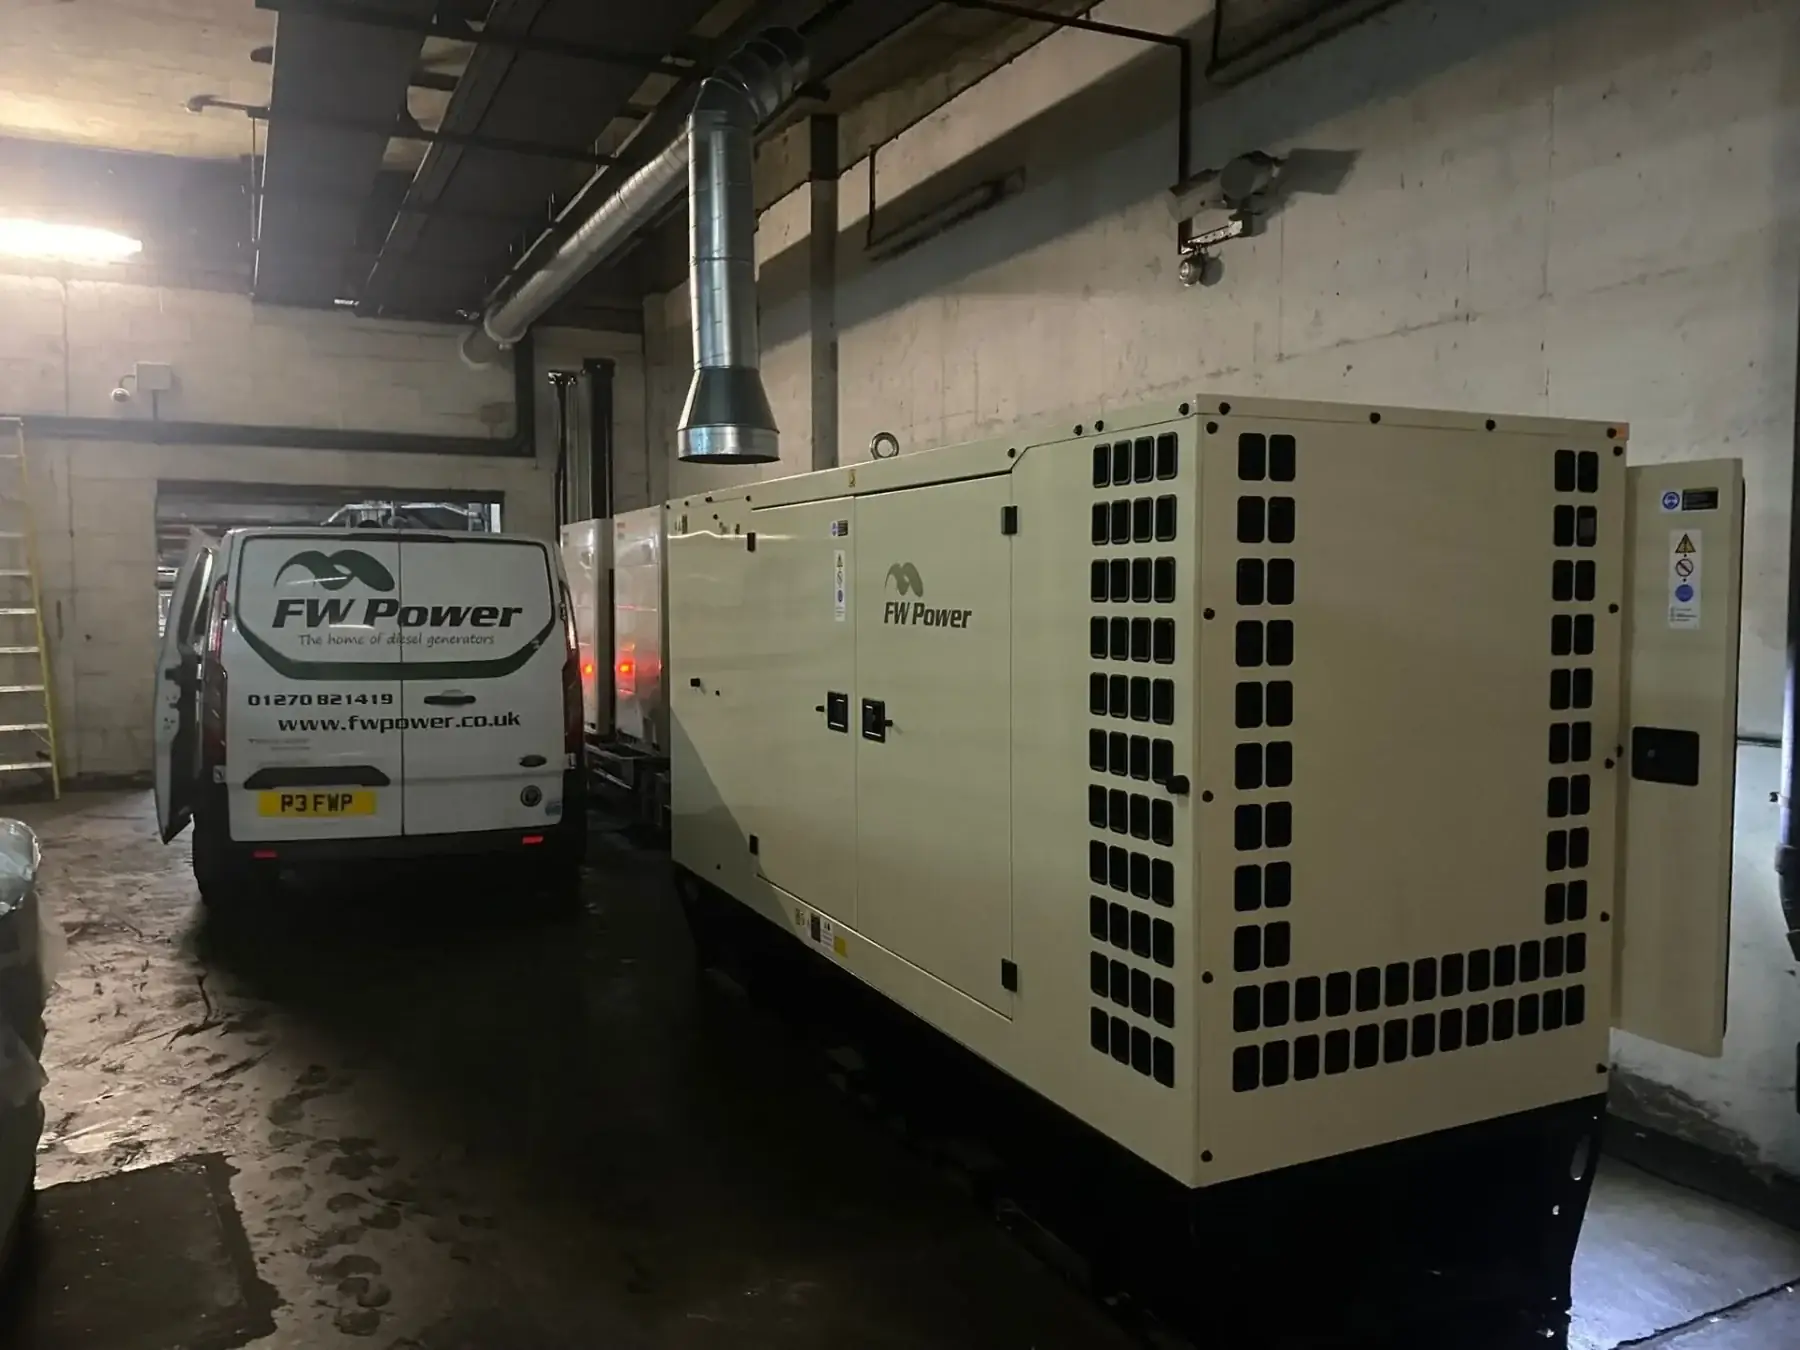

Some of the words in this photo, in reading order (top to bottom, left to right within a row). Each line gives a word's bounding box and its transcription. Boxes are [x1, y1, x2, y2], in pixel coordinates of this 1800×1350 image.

[272, 598, 356, 628] FW
[363, 598, 523, 628] Power
[884, 602, 910, 625] FW
[912, 602, 972, 629] Power
[298, 633, 322, 646] The
[328, 632, 364, 646] home
[369, 632, 386, 646] of
[386, 632, 422, 647] diesel
[427, 633, 495, 648] generators
[248, 694, 313, 706] 01270
[317, 693, 393, 706] 821419
[278, 711, 520, 735] www.fwpower.co.uk
[281, 794, 307, 812] P3
[313, 794, 353, 812] FWP
